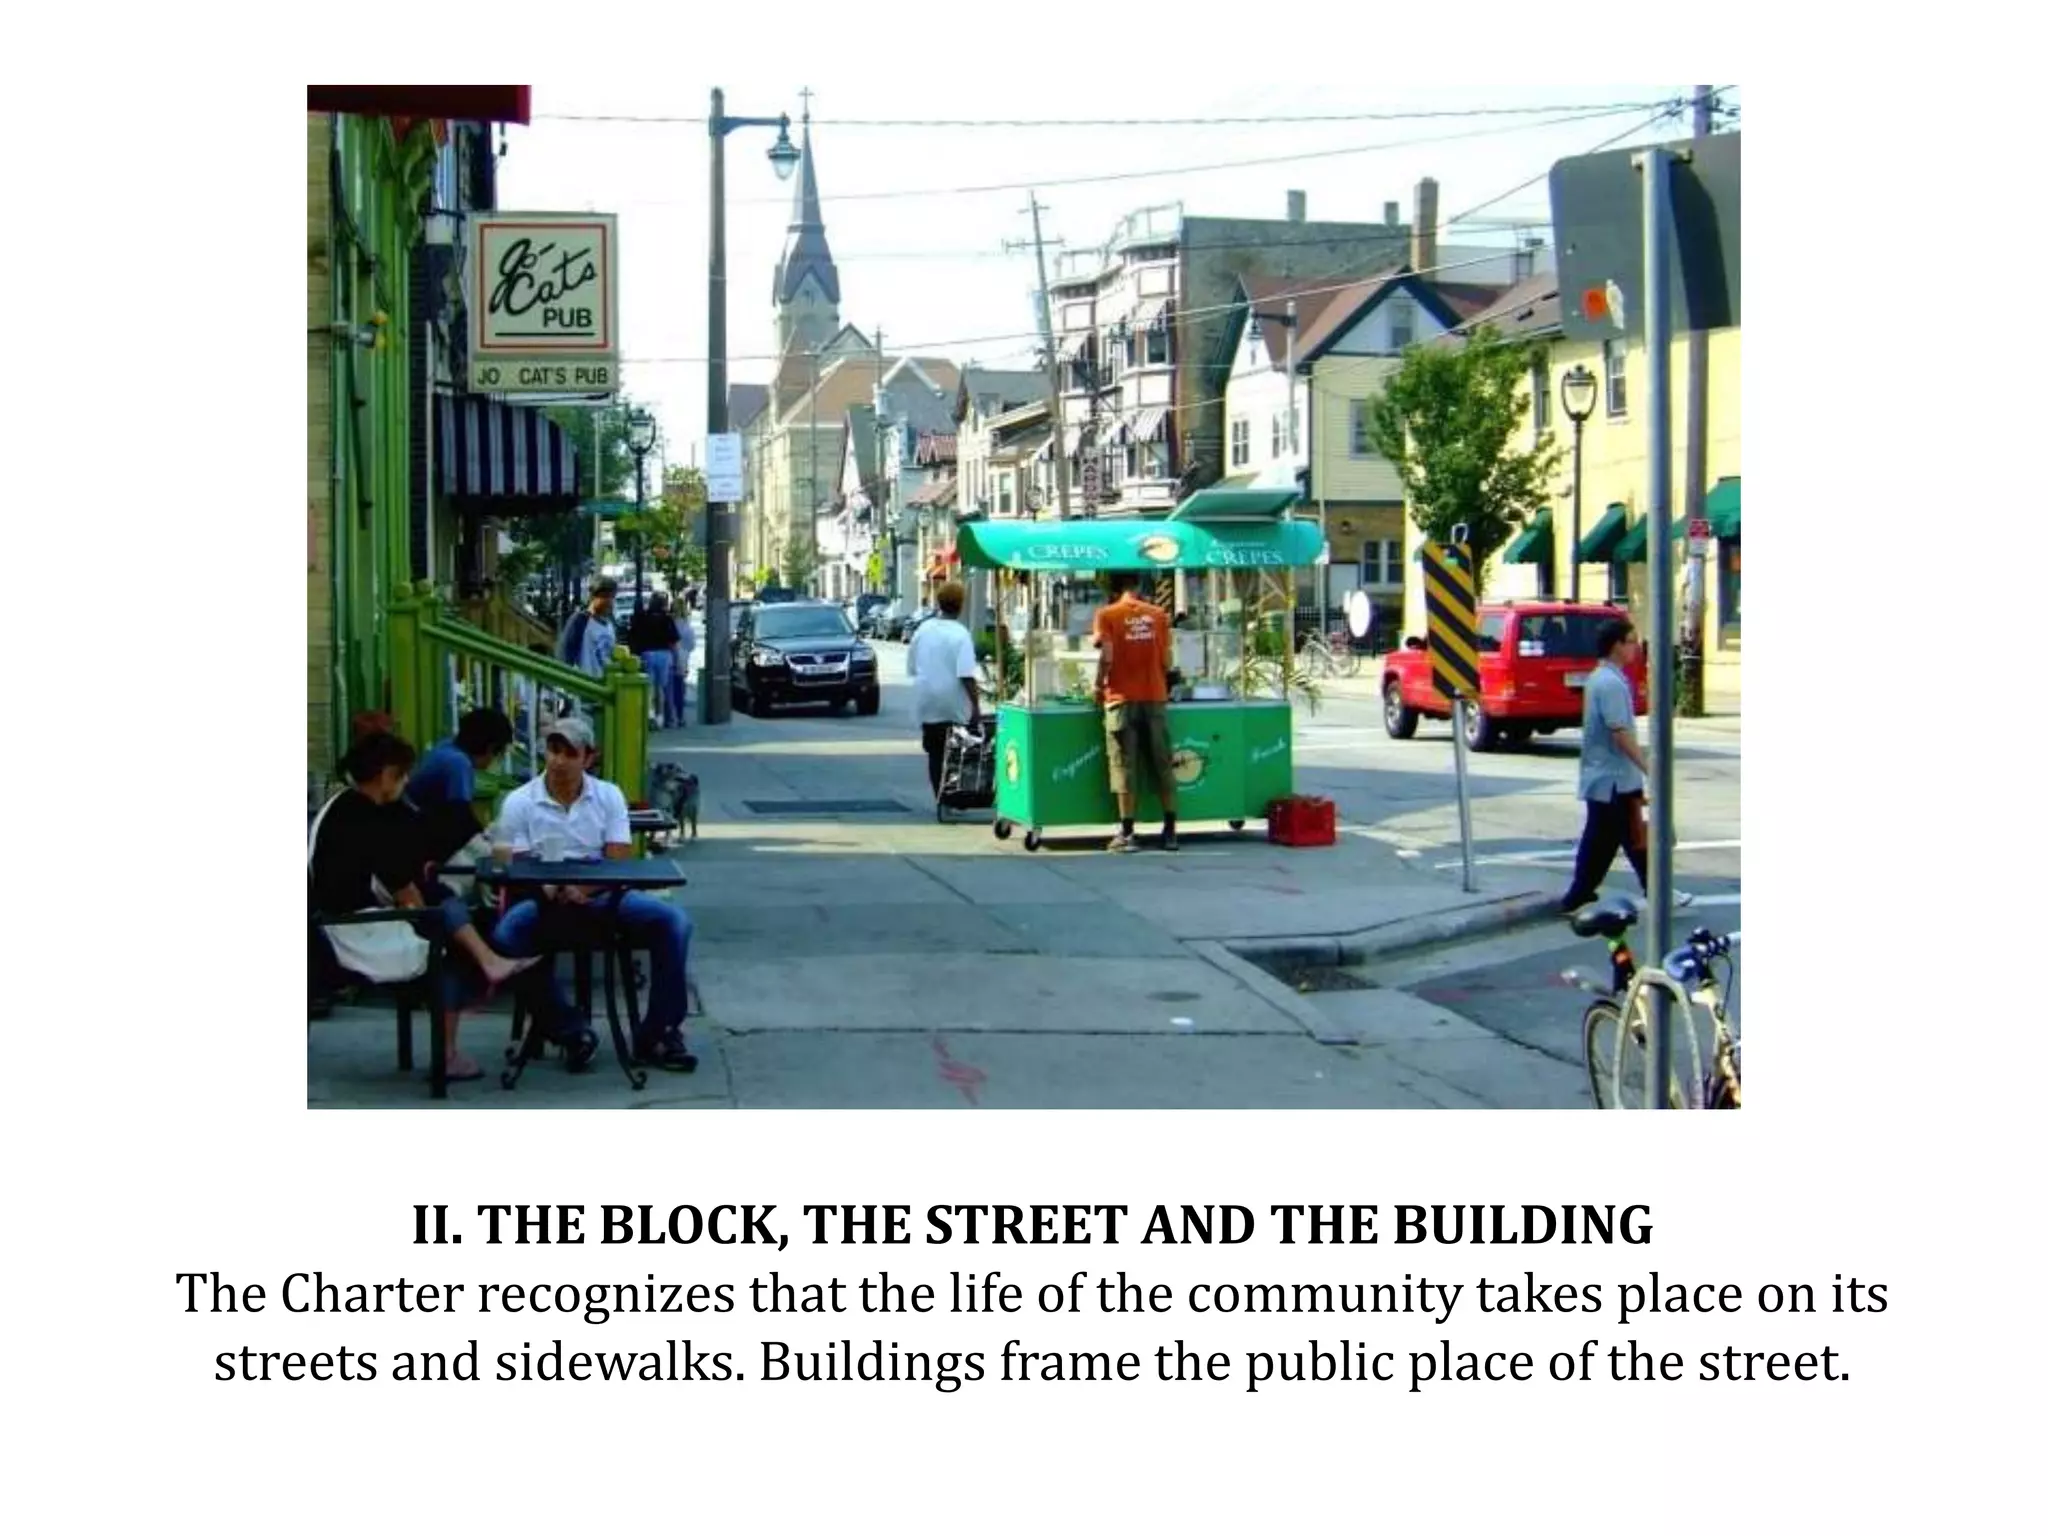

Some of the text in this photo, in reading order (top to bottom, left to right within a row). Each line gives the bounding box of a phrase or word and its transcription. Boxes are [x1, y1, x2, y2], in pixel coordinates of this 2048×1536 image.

[543, 307, 593, 328] PUB
[477, 366, 609, 386] JO CAT'S PUB
